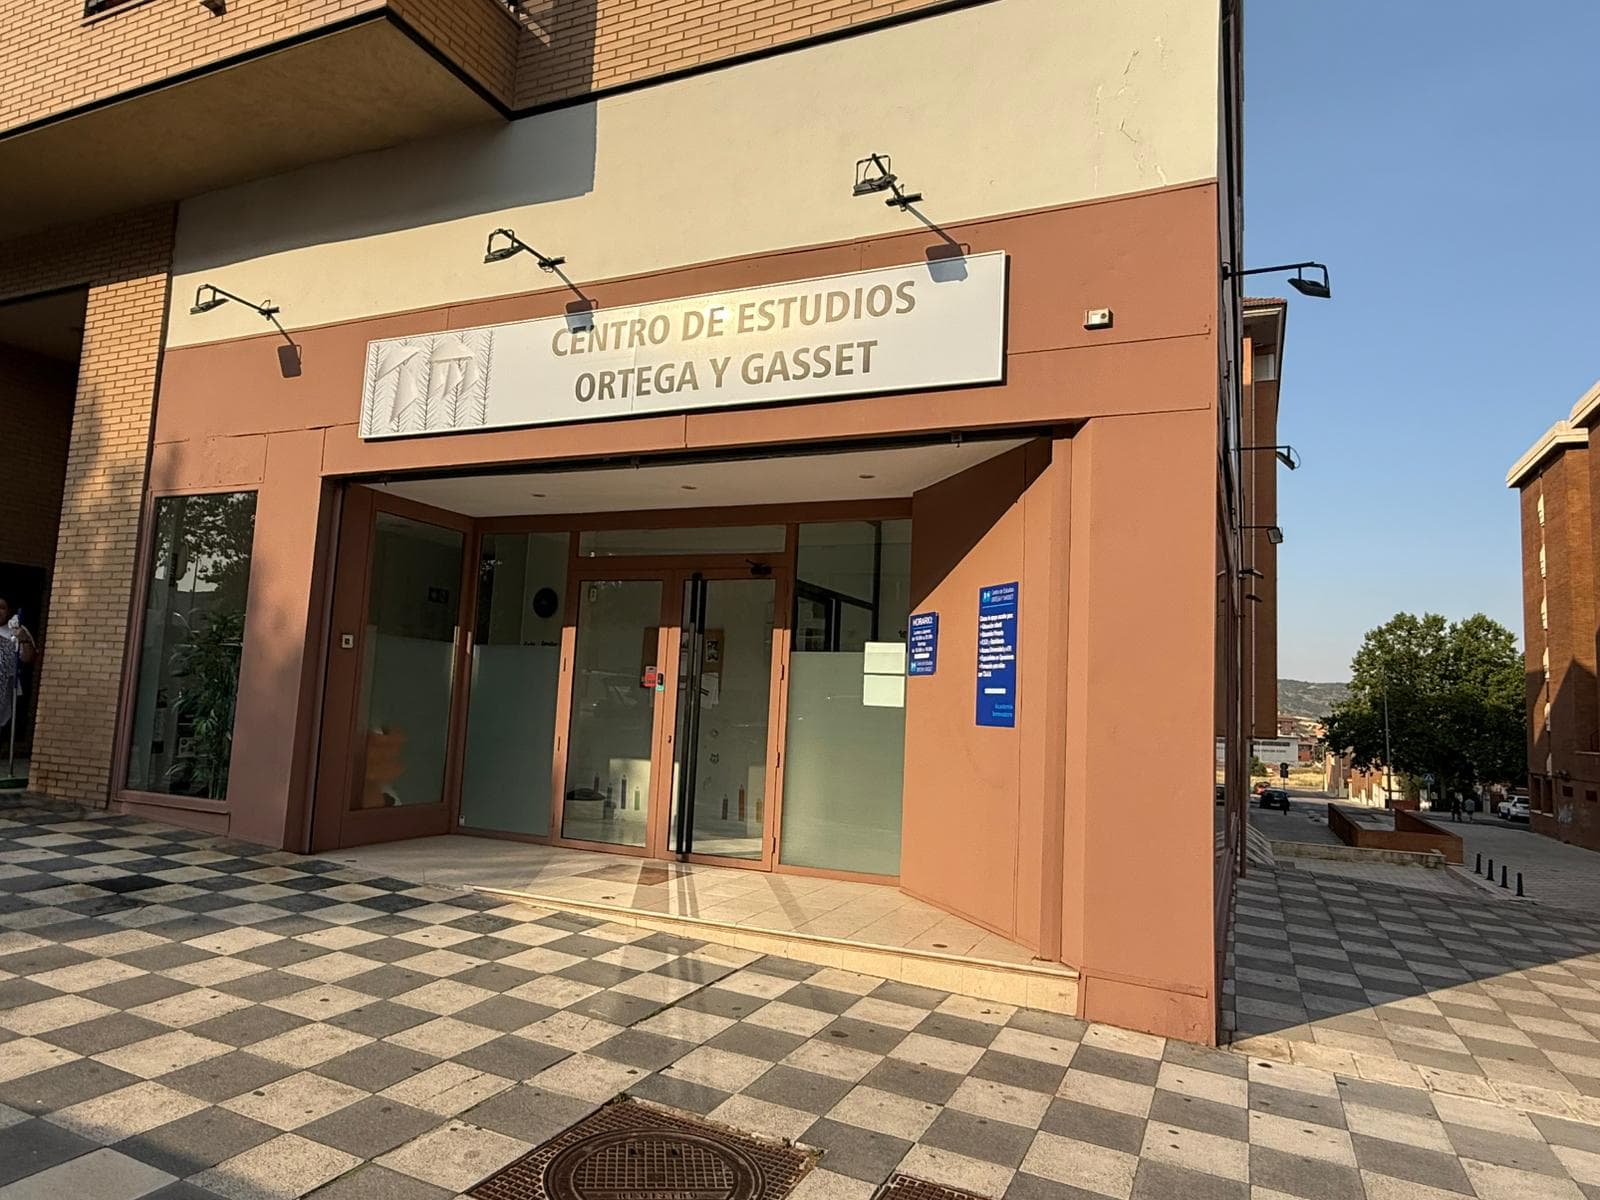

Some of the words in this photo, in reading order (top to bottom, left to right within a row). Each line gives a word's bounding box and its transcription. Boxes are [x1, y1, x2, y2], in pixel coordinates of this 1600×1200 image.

[552, 315, 671, 357] CENTRO
[681, 306, 726, 341] DE
[737, 280, 916, 334] ESTUDIOS
[575, 361, 700, 403] ORTEGA
[709, 356, 732, 389] Y
[741, 339, 878, 386] GASSET
